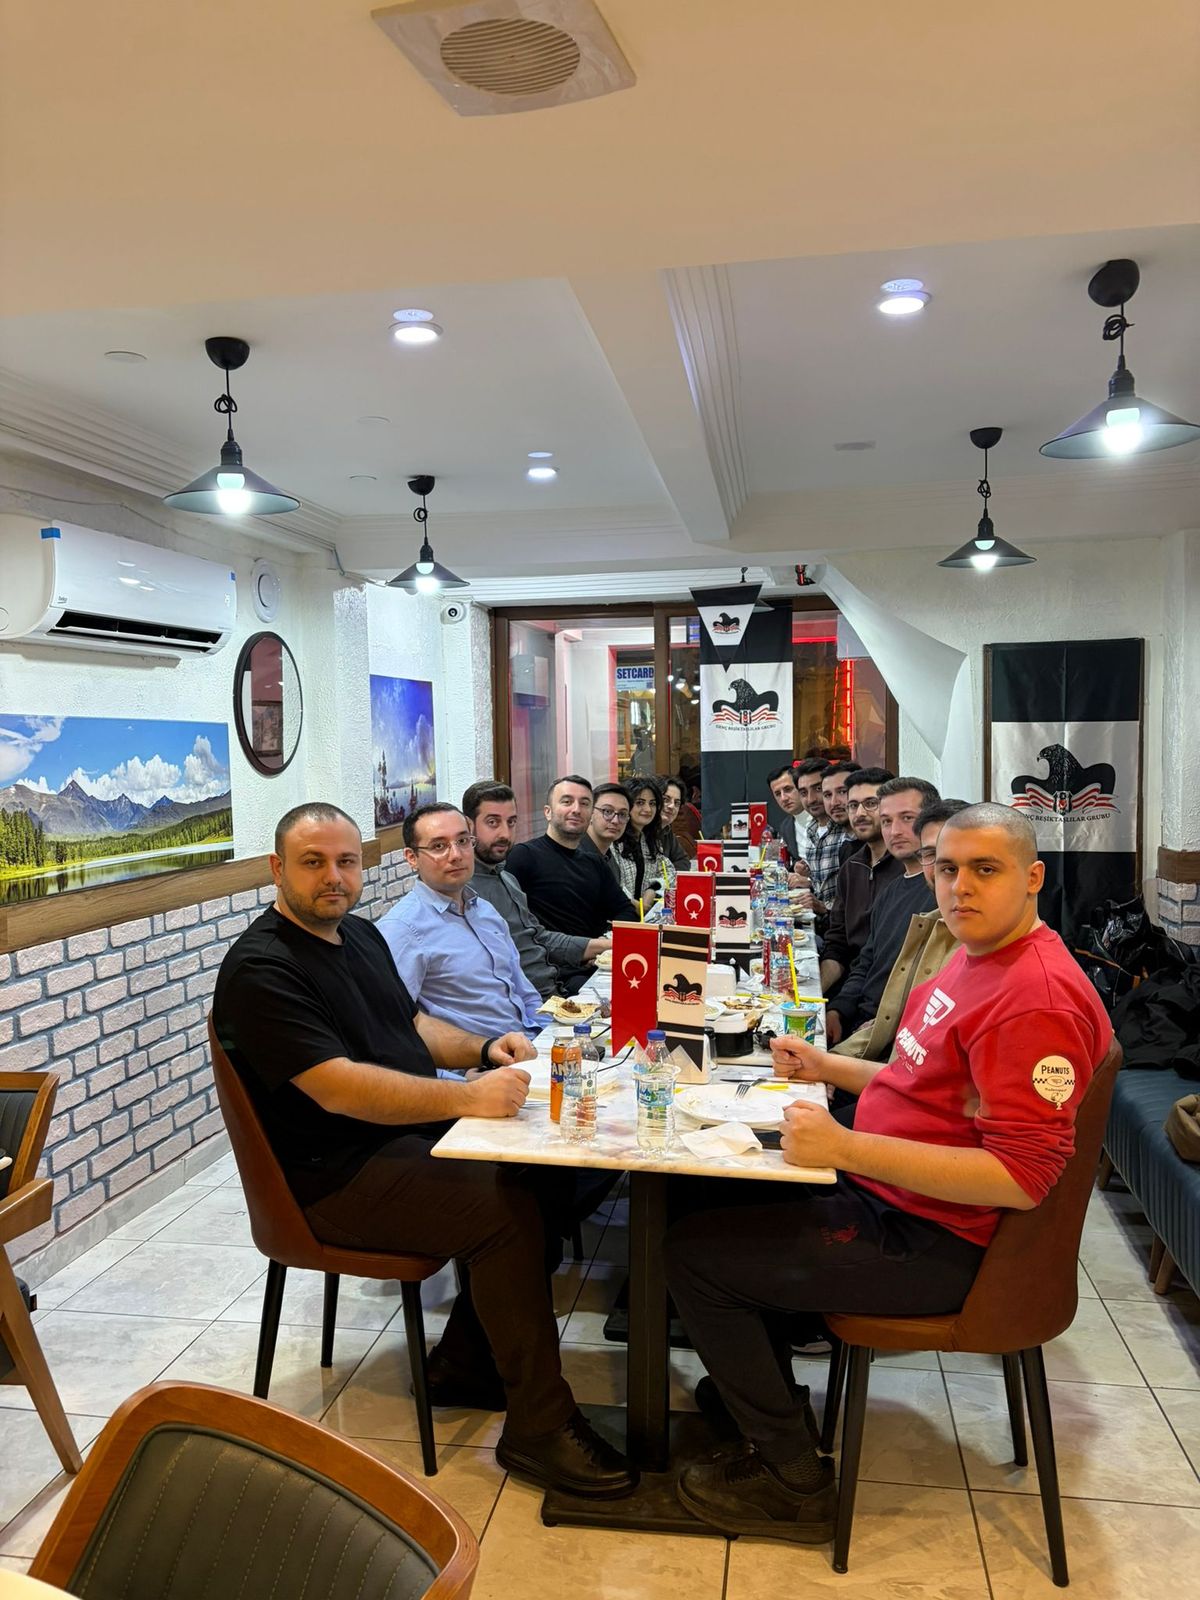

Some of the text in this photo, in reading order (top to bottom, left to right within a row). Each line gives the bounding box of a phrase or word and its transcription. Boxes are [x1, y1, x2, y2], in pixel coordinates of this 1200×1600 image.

[616, 667, 654, 679] SETCARD
[1086, 812, 1111, 821] GRUBU
[896, 1027, 928, 1066] PEANUTS
[1041, 1065, 1070, 1075] PEANUTS
